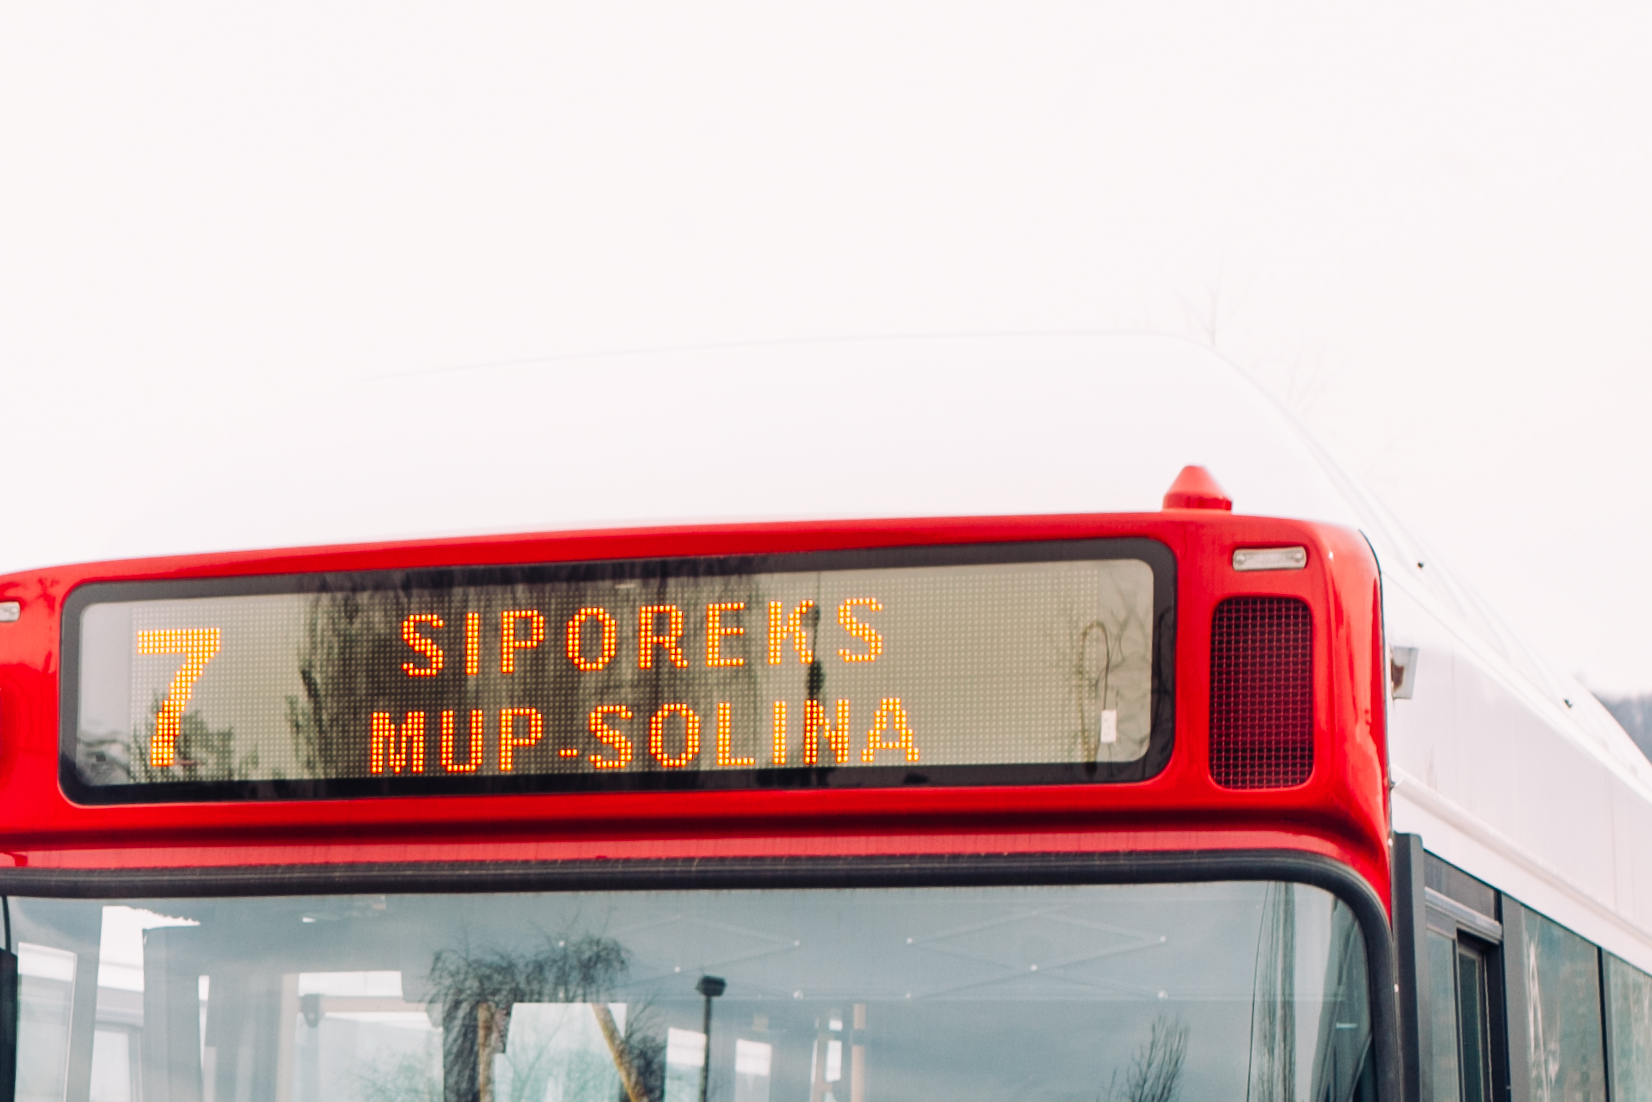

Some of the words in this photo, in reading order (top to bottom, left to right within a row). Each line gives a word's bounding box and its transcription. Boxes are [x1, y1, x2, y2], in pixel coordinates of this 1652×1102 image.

[402, 597, 884, 677] SIPOREKS
[136, 628, 221, 768] 7
[369, 697, 921, 775] MUP-SOLINA
